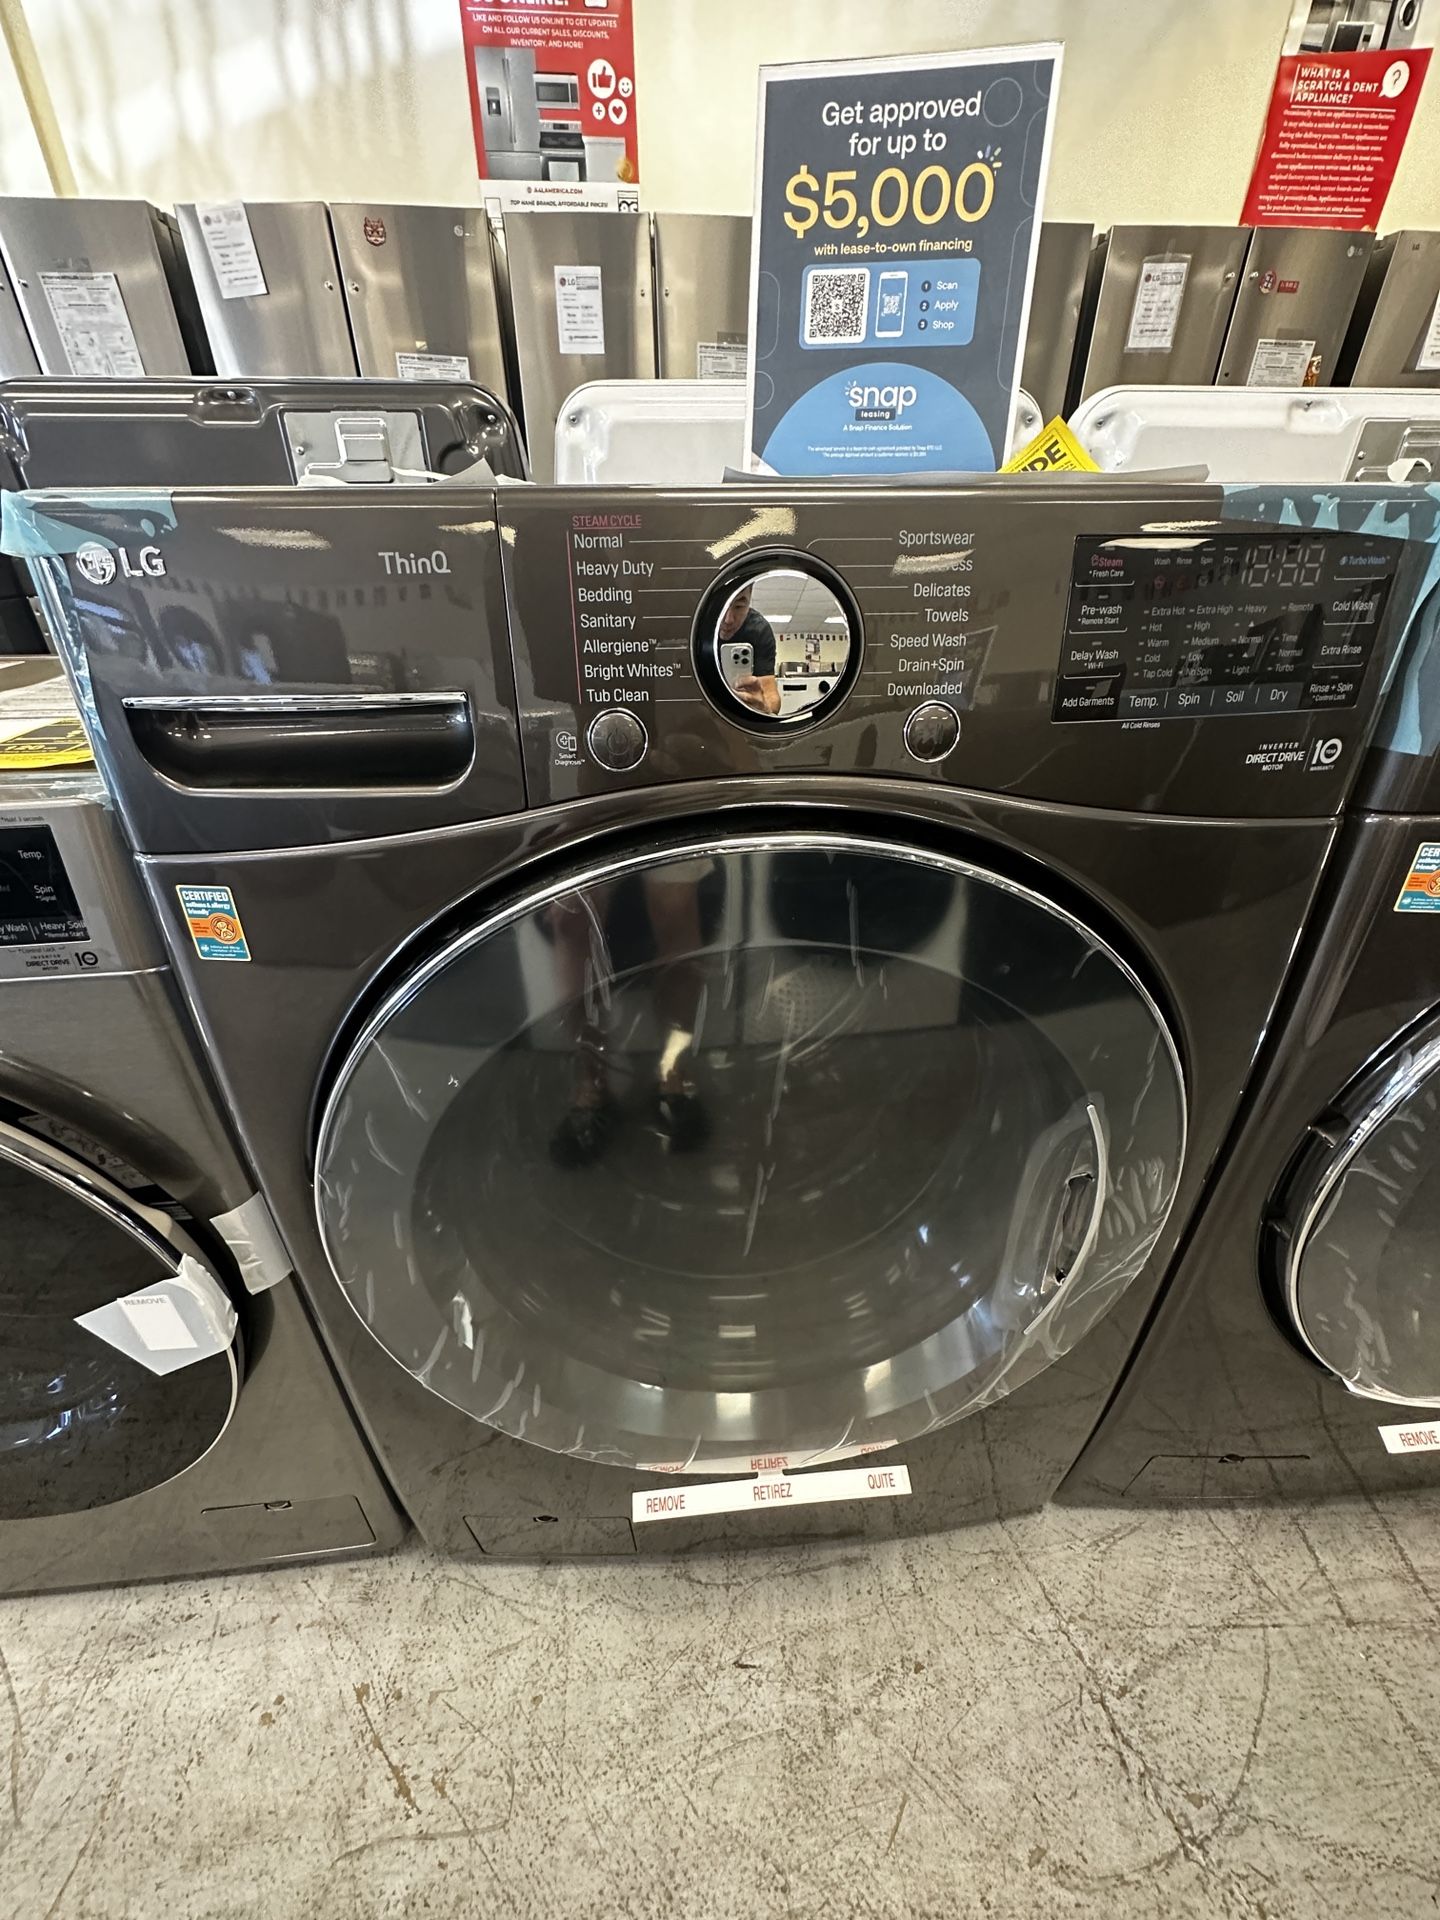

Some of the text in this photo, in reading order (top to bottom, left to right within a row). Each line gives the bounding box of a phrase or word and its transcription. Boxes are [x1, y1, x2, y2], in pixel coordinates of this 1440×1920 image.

[1301, 67, 1350, 78] WHAT IS A
[1298, 80, 1379, 93] SCRATCH & DENT
[1295, 92, 1353, 104] APPLIANCE?
[822, 90, 982, 129] Get approved
[849, 129, 947, 160] for up to
[783, 162, 995, 239] $5,000
[814, 238, 973, 256] with lease-to-own financing
[936, 280, 958, 290] Scan
[934, 300, 959, 312] Apply
[932, 320, 955, 331] Shop
[848, 384, 918, 415] snap
[860, 410, 891, 420] leasing
[572, 514, 642, 528] STEAM CYCLE
[574, 533, 623, 549] Normal
[898, 529, 975, 548] Sportswear
[118, 545, 167, 578] LG
[378, 550, 452, 575] ThinQ
[1099, 557, 1124, 568] Steam
[1154, 555, 1234, 566] Wash Rinse Spin Dry
[576, 560, 654, 578] Heavy Duty
[1110, 569, 1125, 577] Care
[578, 587, 633, 604] Bedding
[913, 582, 971, 598] Delicates
[1080, 604, 1123, 615] Pre-wash
[1151, 606, 1186, 616] Extra Hot
[1196, 603, 1234, 615] Extra High
[1244, 604, 1268, 615] Heavy
[1332, 600, 1374, 611] Cold Wash
[924, 608, 969, 622] Towels
[1104, 616, 1120, 625] Start
[580, 613, 637, 630] Sanitary
[1193, 620, 1211, 631] High
[1148, 623, 1163, 632] Hot
[890, 633, 967, 650] Speed Wash
[1190, 637, 1220, 646] Medium
[1237, 634, 1265, 644] Normal
[1281, 633, 1298, 642] Time
[1147, 639, 1170, 648] Warm
[1070, 649, 1119, 662] Delay Wash
[1278, 648, 1303, 657] Normal
[1321, 645, 1362, 656] Extra Rinse
[1144, 654, 1161, 663] Cold
[1188, 653, 1204, 662] Low
[898, 657, 965, 673] Drain+Spin
[1232, 665, 1251, 675] Light
[1275, 664, 1295, 673] Turbo
[584, 664, 625, 680] Bright
[1143, 668, 1173, 679] Tap Cold
[1197, 667, 1213, 677] Spin
[887, 681, 963, 696] Downloaded
[1309, 683, 1330, 693] Rinse
[1336, 682, 1354, 693] Spin
[586, 688, 649, 702] Tub Clean
[1129, 689, 1289, 709] Temp. Spin Soil Dry
[1062, 696, 1115, 708] Add Garments
[1121, 722, 1130, 730] All
[1258, 742, 1300, 751] INVERTER
[1311, 737, 1343, 765] 10
[1245, 751, 1306, 765] DIRECT DRIVE
[1262, 764, 1284, 772] MOTOR
[33, 885, 55, 895] Spin
[181, 890, 229, 902] CERTIFIED
[6, 923, 29, 932] Wash
[40, 921, 66, 932] Heavy
[25, 958, 71, 968] DIRECT DRIVE
[75, 951, 99, 967] 10
[124, 1297, 167, 1306] REMOVE
[1399, 1430, 1440, 1447] REMOVE
[646, 1472, 896, 1513] REMOVE RETIREZ QUITE
